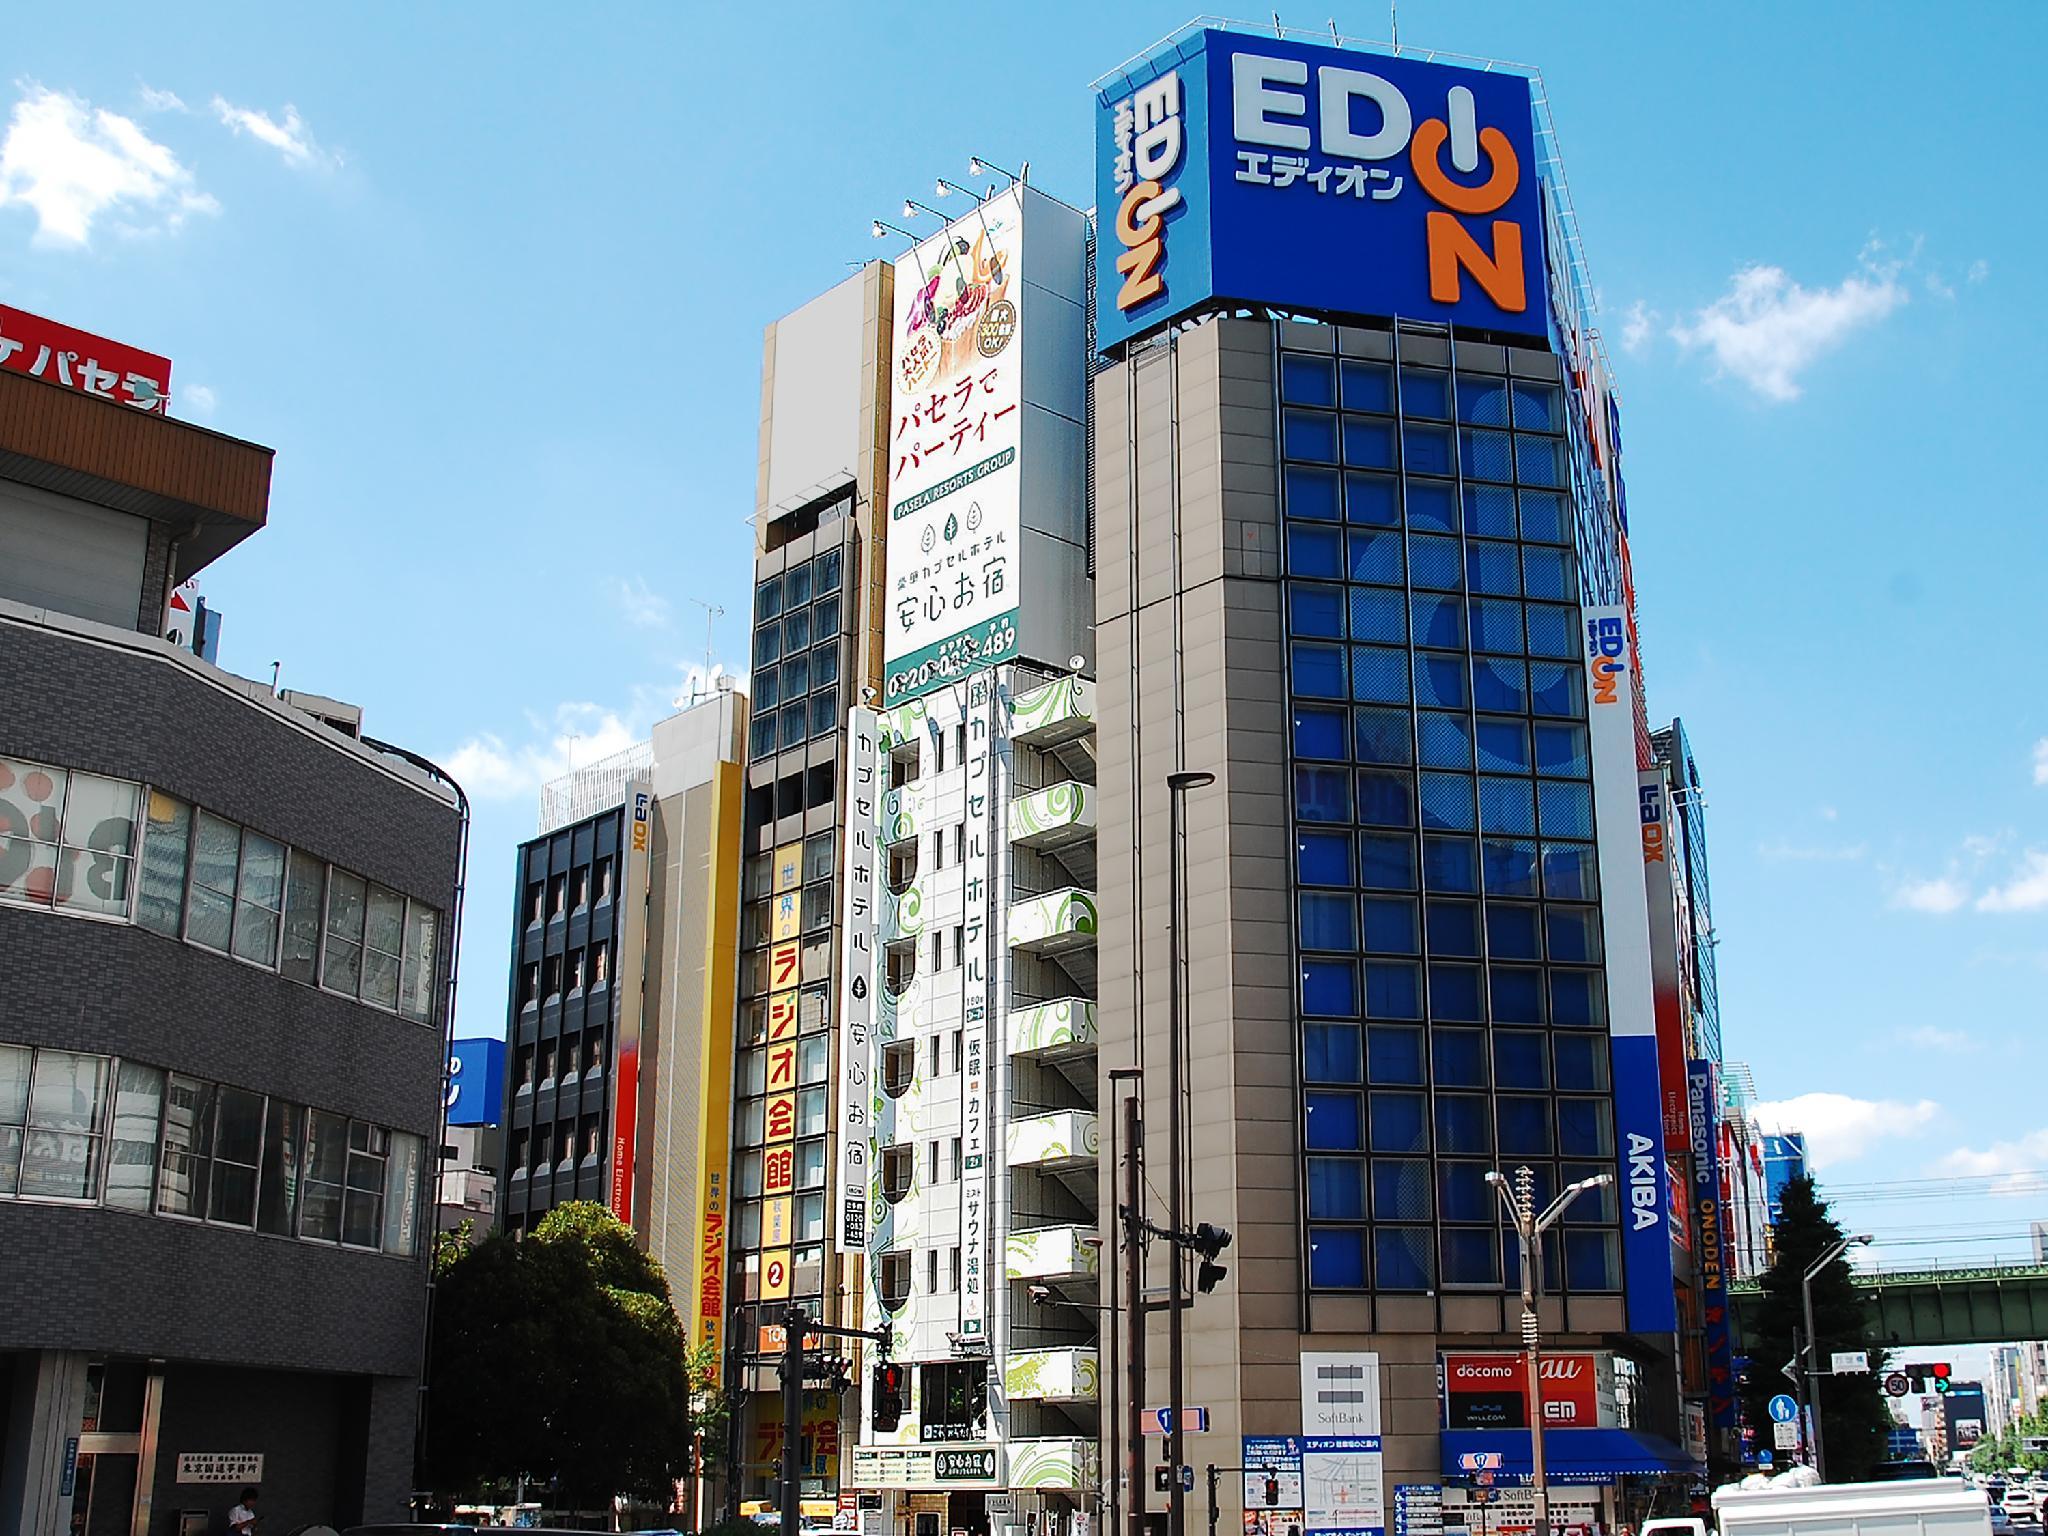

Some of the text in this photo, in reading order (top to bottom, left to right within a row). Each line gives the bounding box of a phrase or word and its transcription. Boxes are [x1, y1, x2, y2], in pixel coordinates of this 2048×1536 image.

[1235, 151, 1402, 200] エディオン
[897, 368, 998, 441] パセラで
[895, 404, 1017, 481] パーティー
[897, 450, 1011, 518] PASELA RESORTS GROUP
[897, 556, 1006, 632] 安心お宿
[852, 732, 872, 953] カプセルホテル
[848, 1022, 867, 1166] 安心お宿
[1689, 1073, 1715, 1184] Panasonic
[616, 1137, 626, 1166] Home
[1626, 1132, 1659, 1232] AKIBA
[1700, 1199, 1722, 1290] ONODEN
[1456, 1364, 1512, 1377] docomo
[1540, 1360, 1582, 1379] au
[1891, 1380, 1904, 1391] 50
[1318, 1412, 1364, 1425] SoftBank
[1503, 1488, 1535, 1501] SoftB
